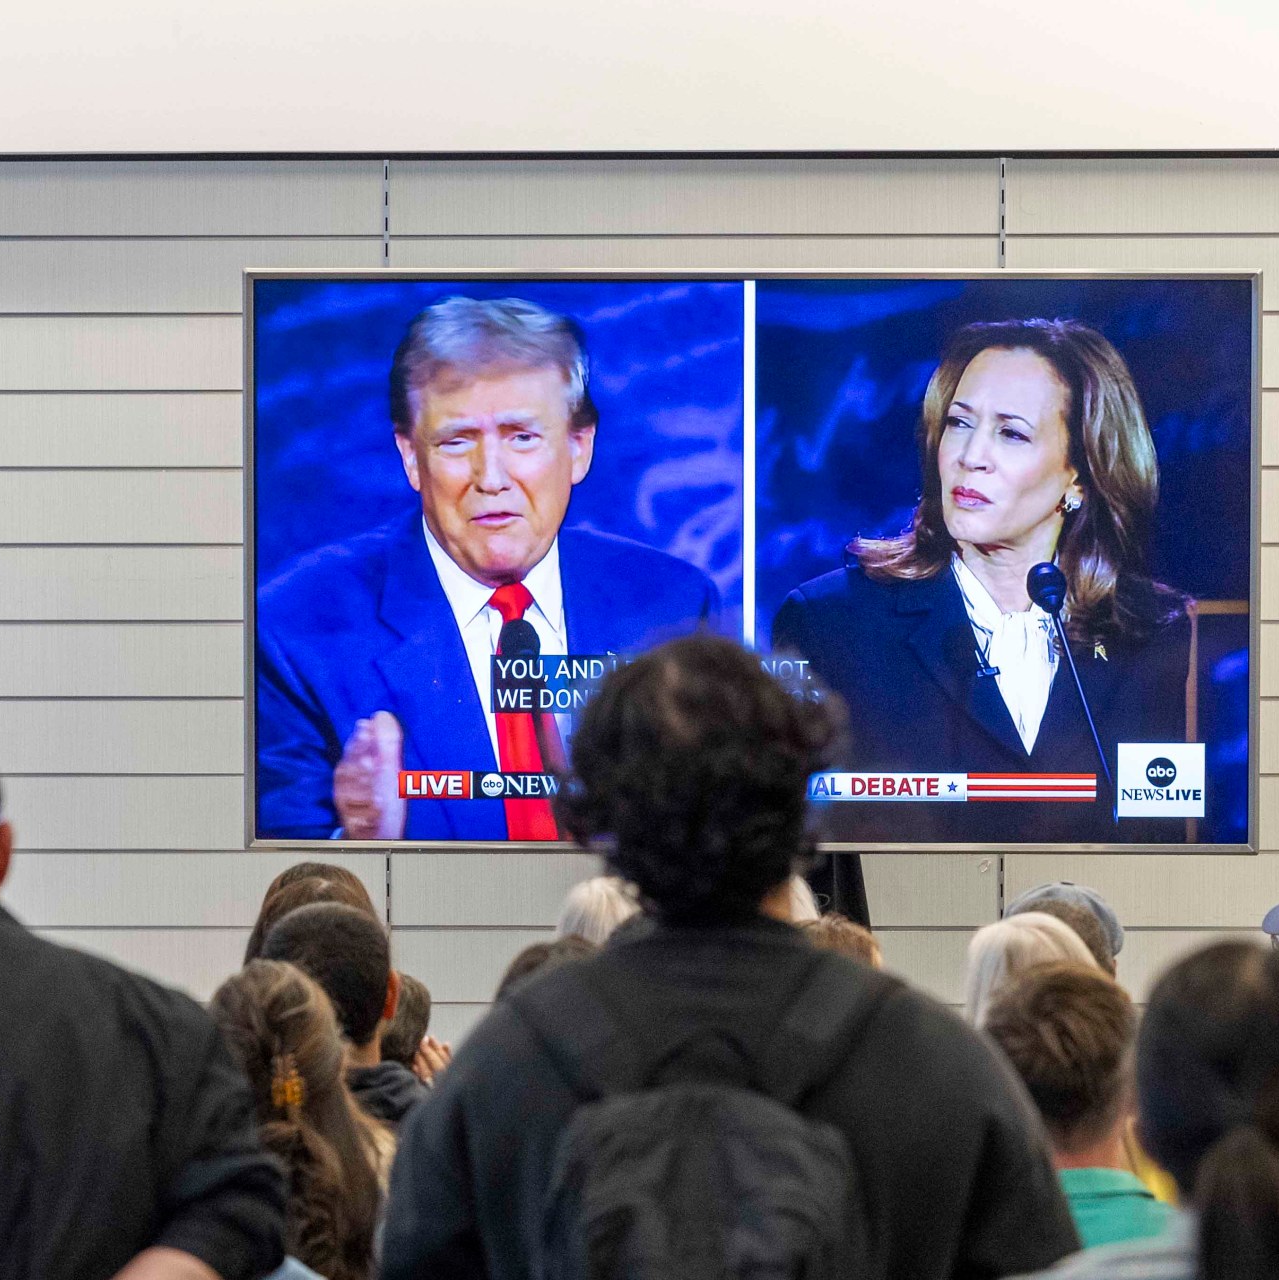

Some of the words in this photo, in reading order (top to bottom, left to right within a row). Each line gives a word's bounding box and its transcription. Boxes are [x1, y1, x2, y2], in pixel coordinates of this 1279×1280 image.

[495, 659, 549, 683] YOU,
[554, 659, 605, 679] AND
[760, 660, 812, 680] NOT.
[496, 688, 533, 709] WE
[406, 774, 463, 796] LIVE
[504, 775, 565, 796] NEW
[851, 777, 940, 796] DEBATE
